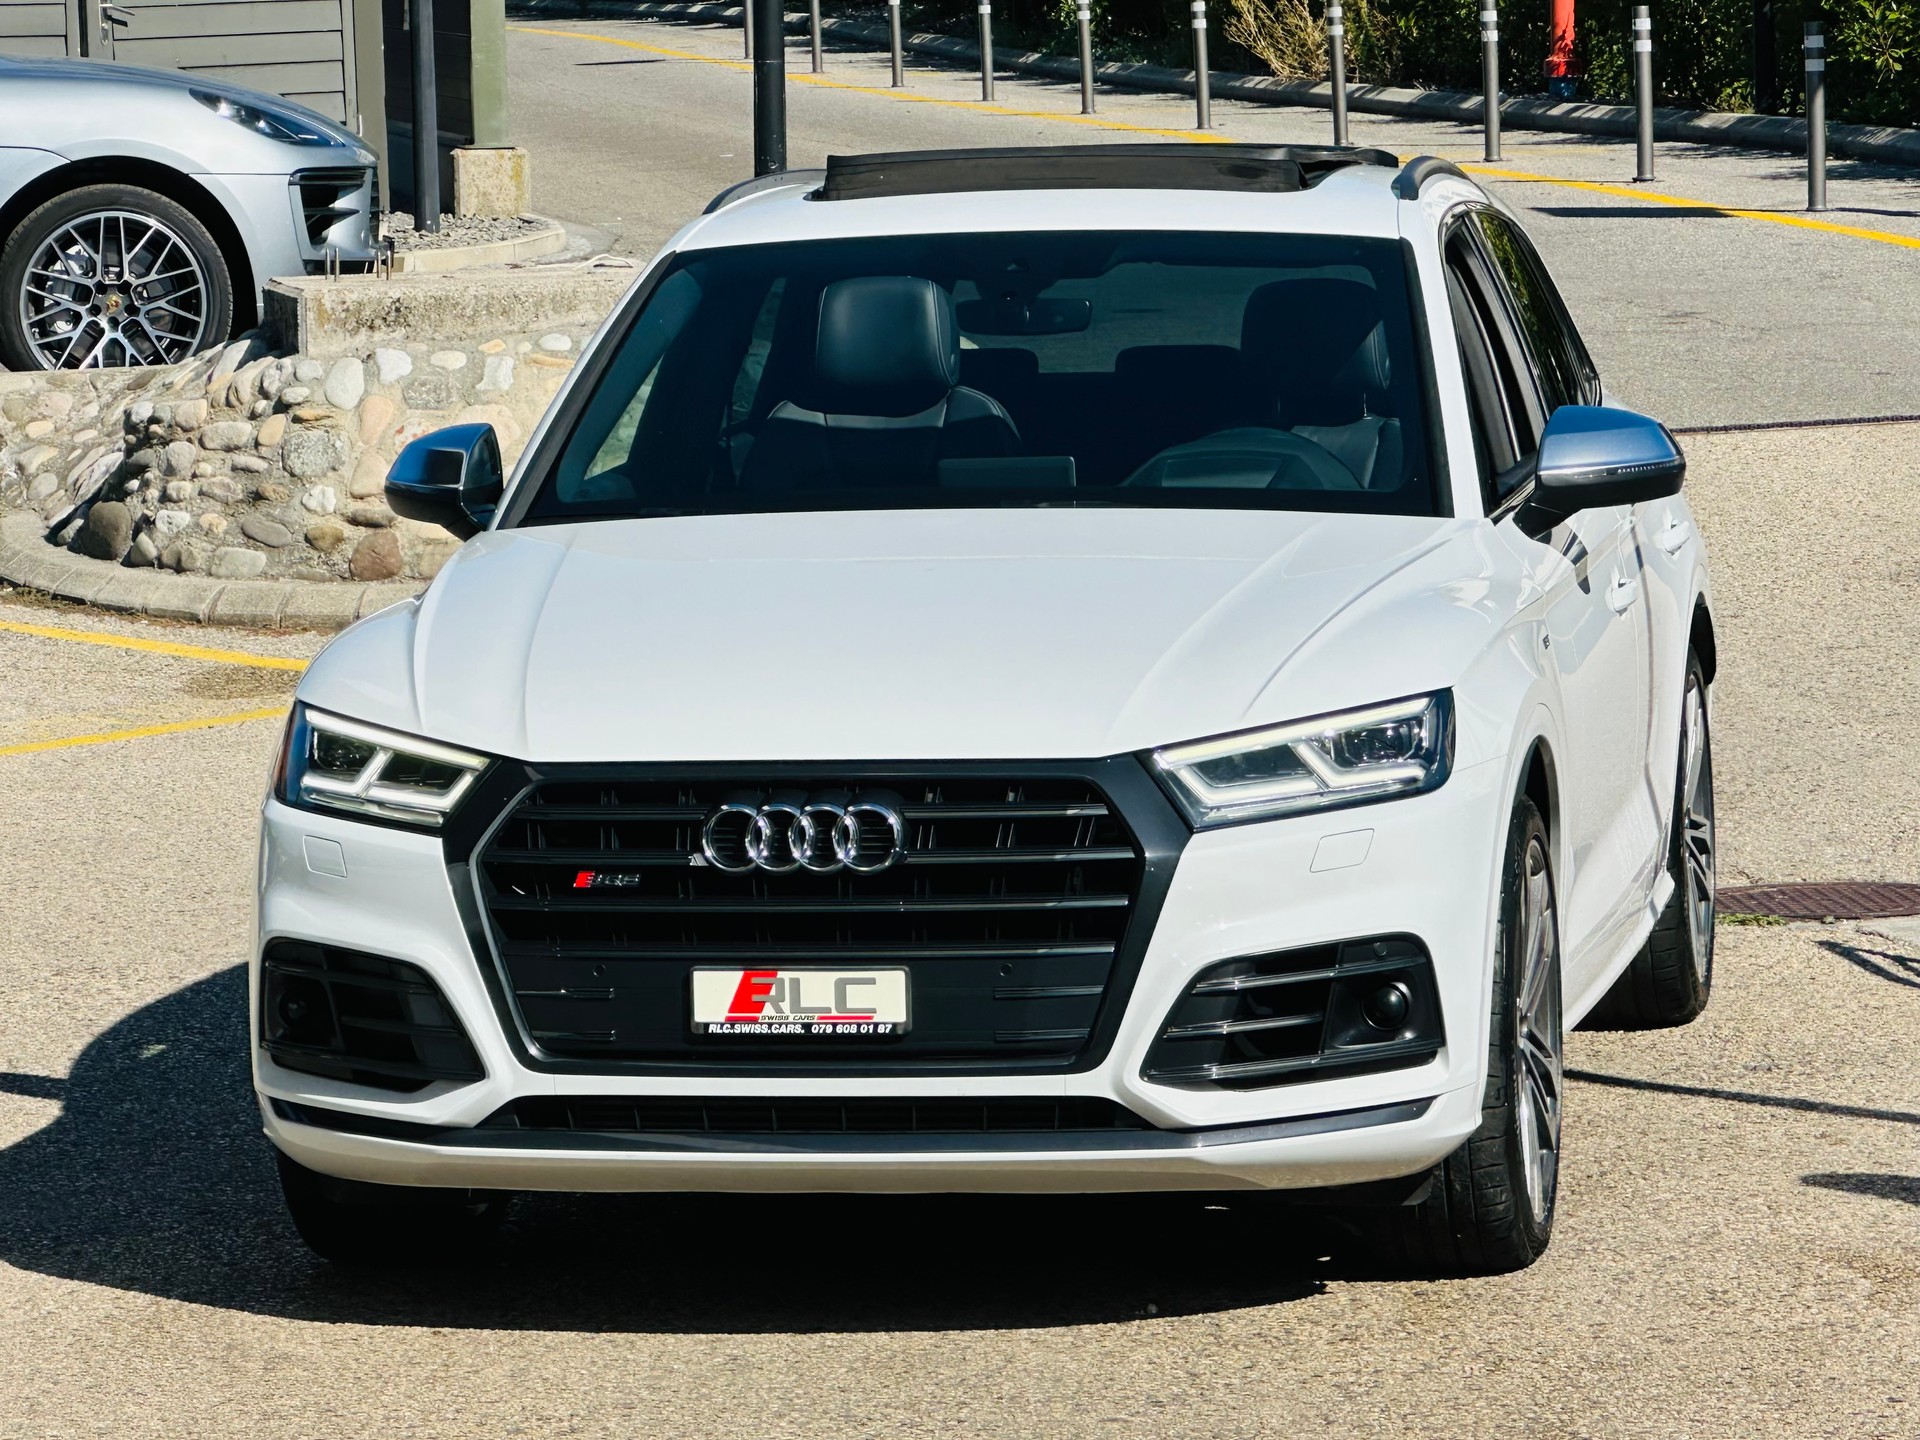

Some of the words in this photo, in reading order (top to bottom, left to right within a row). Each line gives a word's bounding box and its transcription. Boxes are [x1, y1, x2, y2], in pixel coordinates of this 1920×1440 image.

[811, 1023, 833, 1034] 079
[835, 1023, 858, 1034] 608
[859, 1023, 874, 1034] 01
[877, 1023, 893, 1034] 87
